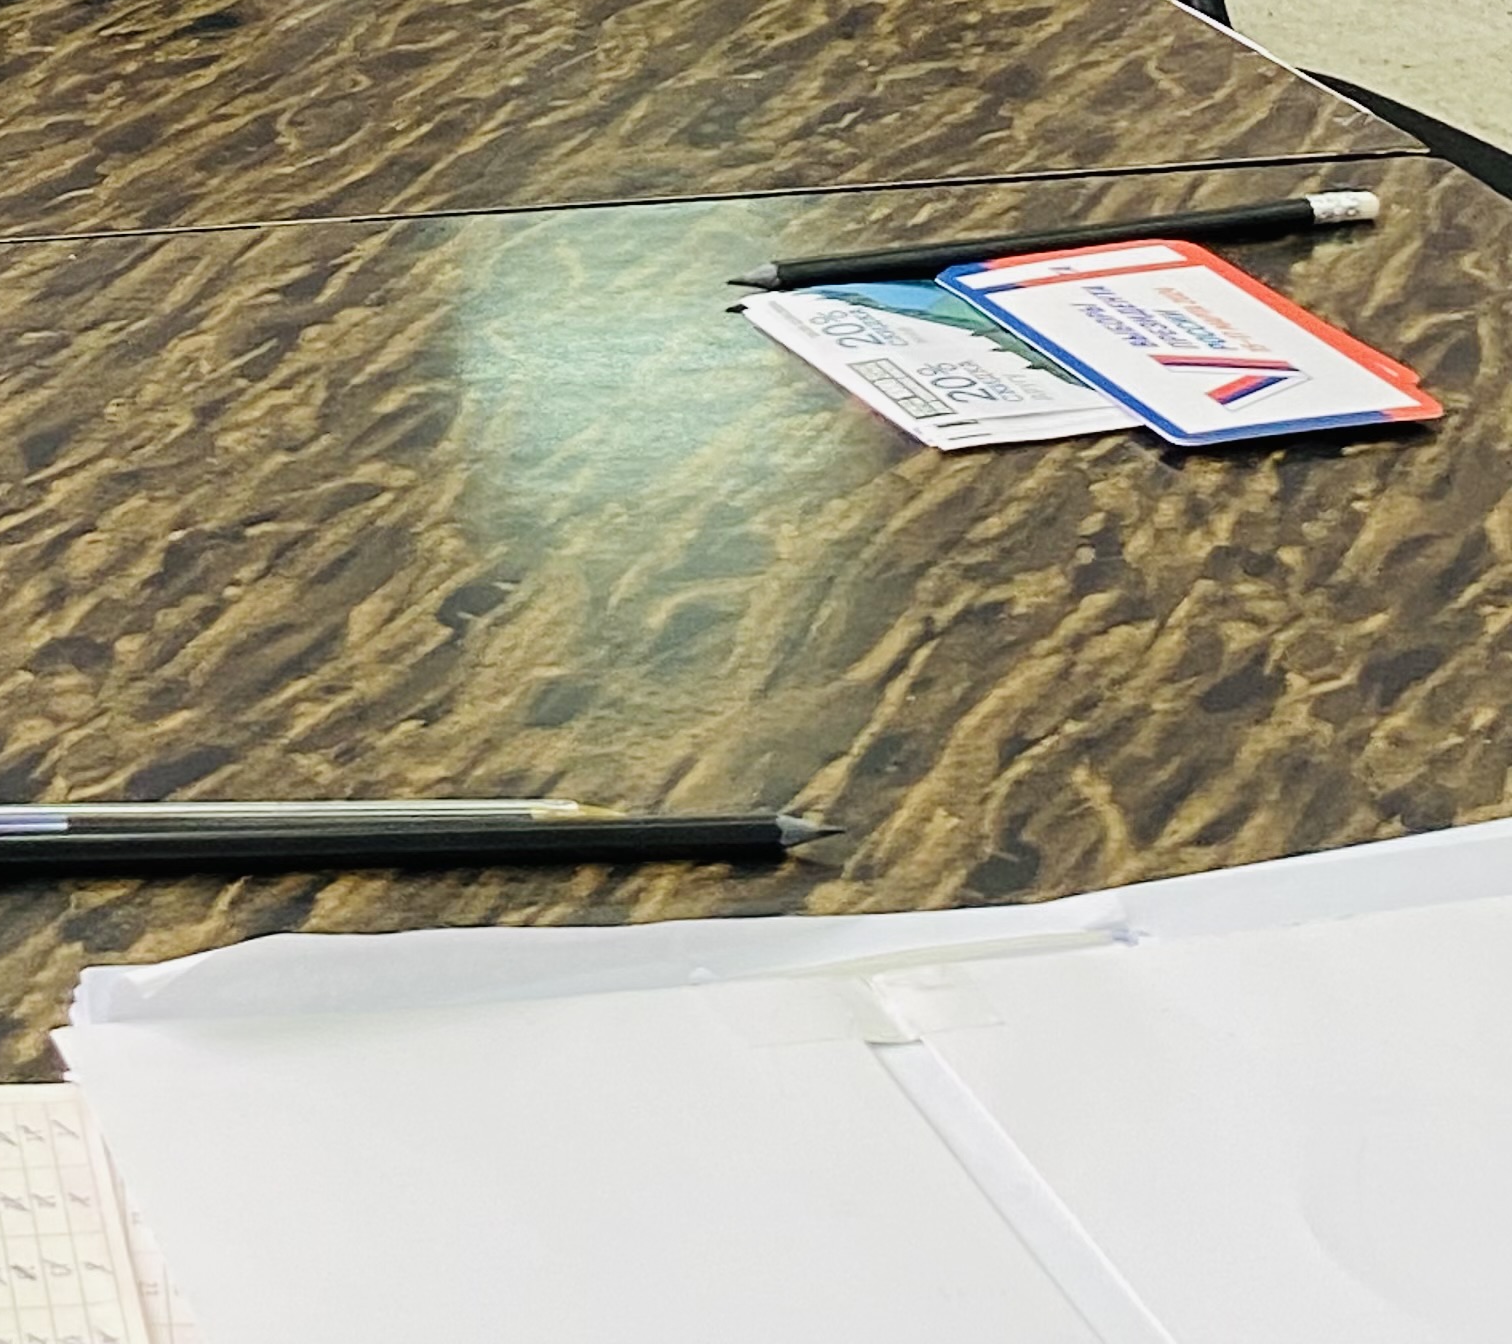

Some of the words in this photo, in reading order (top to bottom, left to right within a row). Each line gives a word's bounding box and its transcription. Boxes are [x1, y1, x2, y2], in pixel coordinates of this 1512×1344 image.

[1070, 303, 1160, 348] ВЫБОРЫ
[1081, 286, 1200, 349] ПРЕЗИДЕНТА
[1154, 310, 1238, 349] РОССИИ
